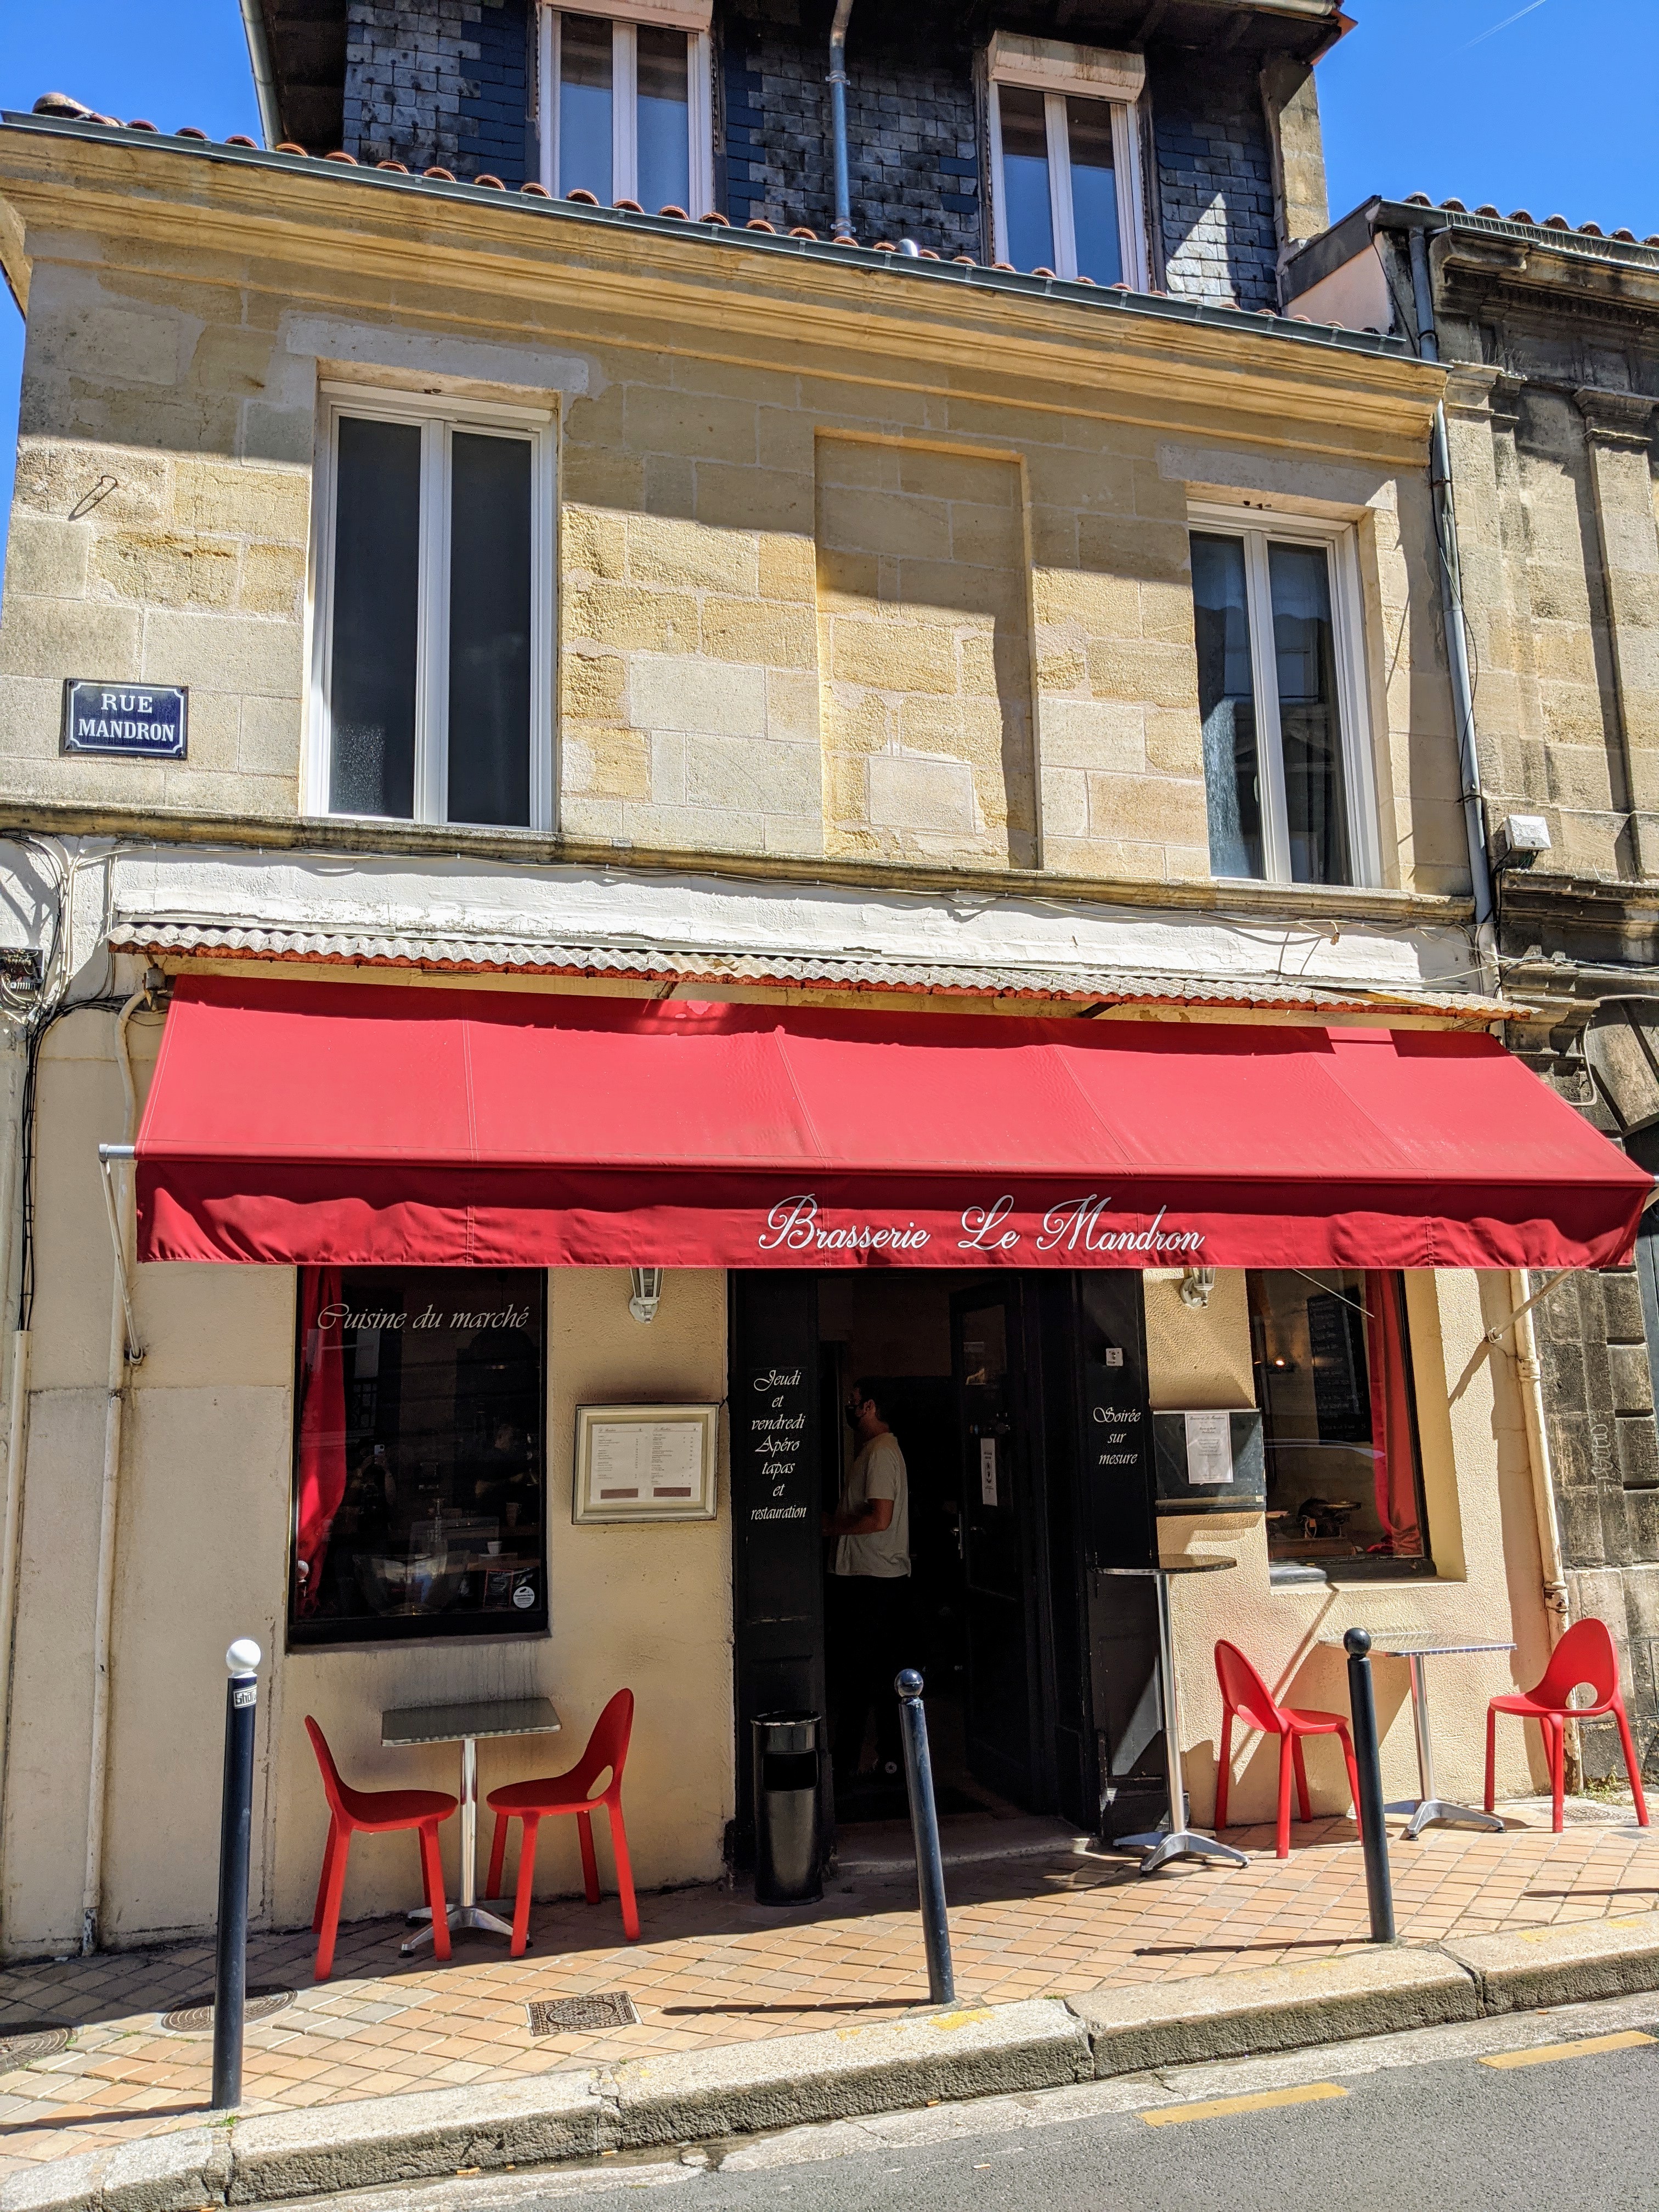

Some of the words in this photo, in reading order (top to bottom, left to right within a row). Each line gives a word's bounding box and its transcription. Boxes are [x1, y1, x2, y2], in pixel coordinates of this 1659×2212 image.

[100, 693, 153, 714] RUE
[78, 719, 175, 742] MANDRON
[758, 1193, 931, 1249] Brasserie
[957, 1195, 1020, 1250] Le
[1036, 1194, 1206, 1252] Mandron
[318, 1304, 407, 1329] Cuisine
[413, 1304, 443, 1329] du
[449, 1305, 529, 1328] marché
[753, 1370, 802, 1391] Jeudi
[771, 1395, 784, 1408] et
[751, 1413, 806, 1430] vendredi
[1093, 1407, 1141, 1423] Soirée
[754, 1435, 800, 1458] Apéro
[1107, 1433, 1126, 1443] sur
[1098, 1454, 1138, 1465] mesure
[761, 1462, 795, 1480] tapas
[772, 1483, 785, 1497] et
[751, 1505, 806, 1520] restauration
